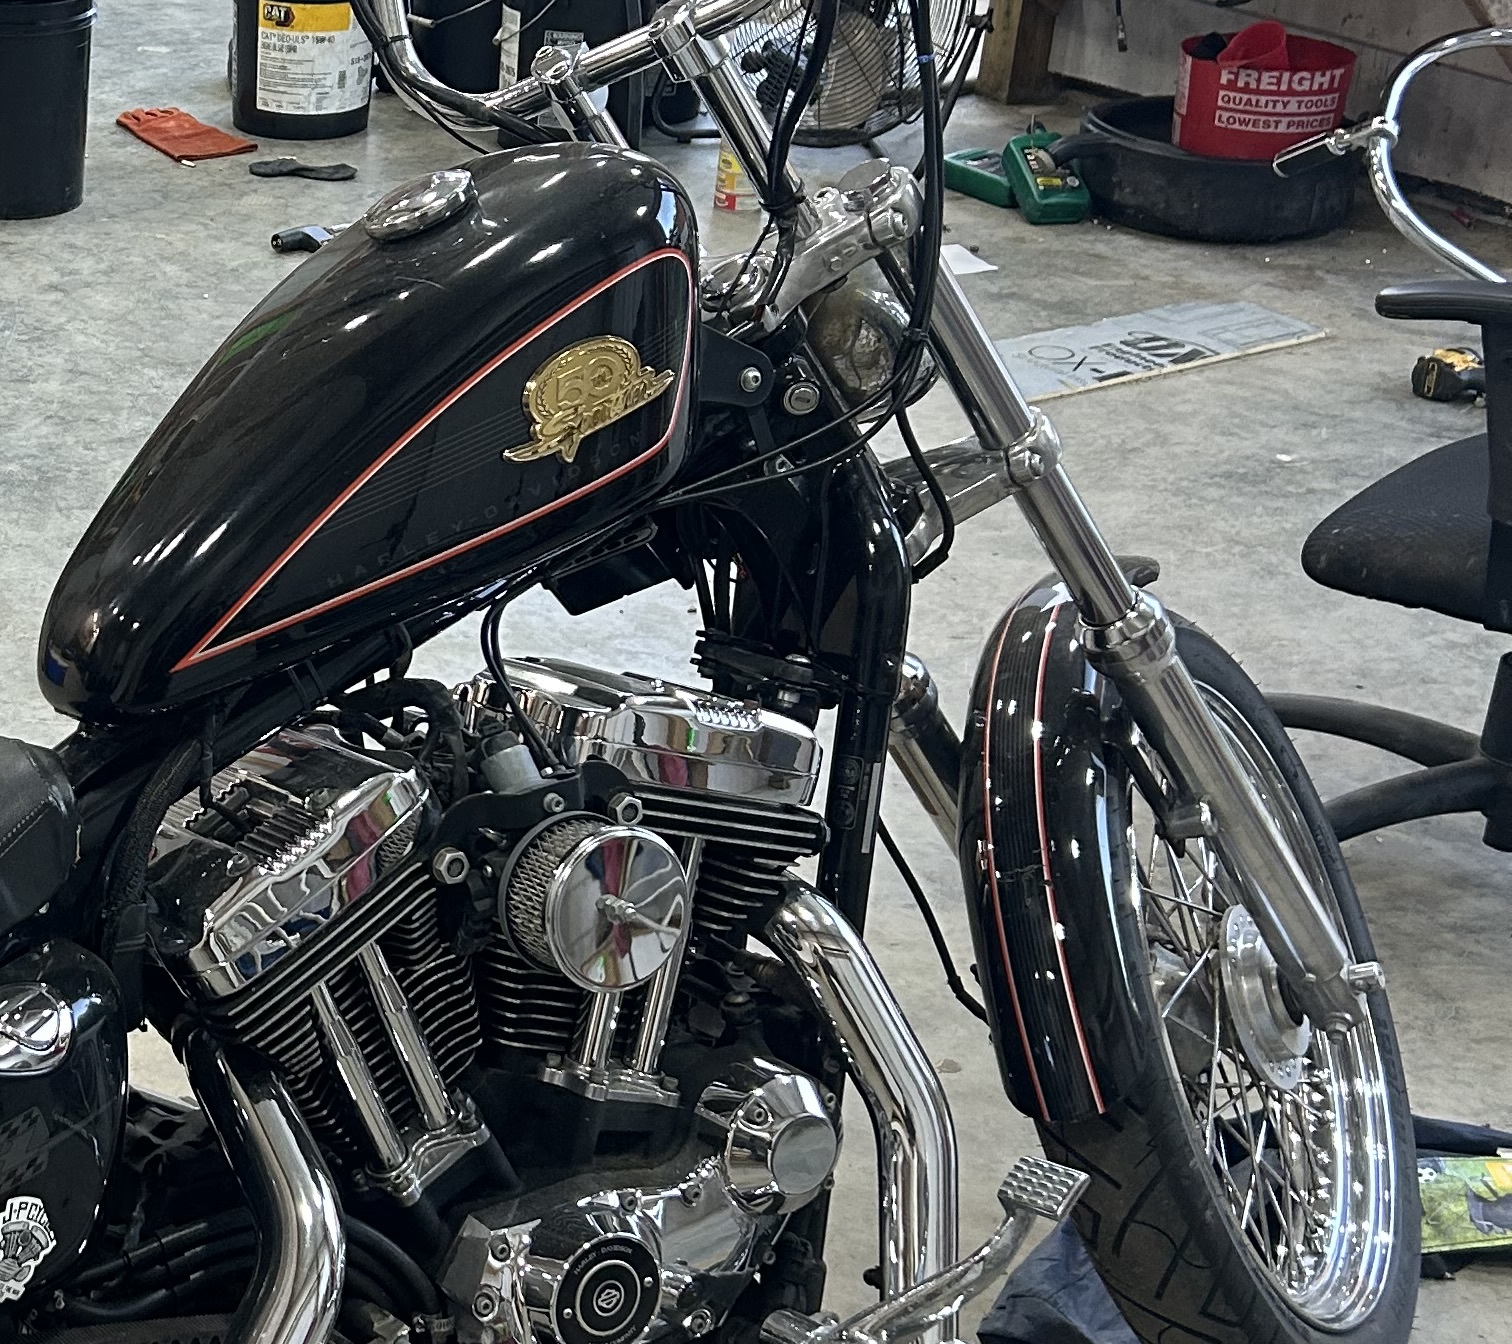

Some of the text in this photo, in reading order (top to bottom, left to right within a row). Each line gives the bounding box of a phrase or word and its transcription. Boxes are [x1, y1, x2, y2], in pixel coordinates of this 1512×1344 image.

[264, 6, 287, 22] CAT
[1219, 68, 1345, 92] FREIGHT
[1221, 94, 1337, 110] QUALITY TOOLS
[1217, 113, 1332, 130] LOWEST PRICES
